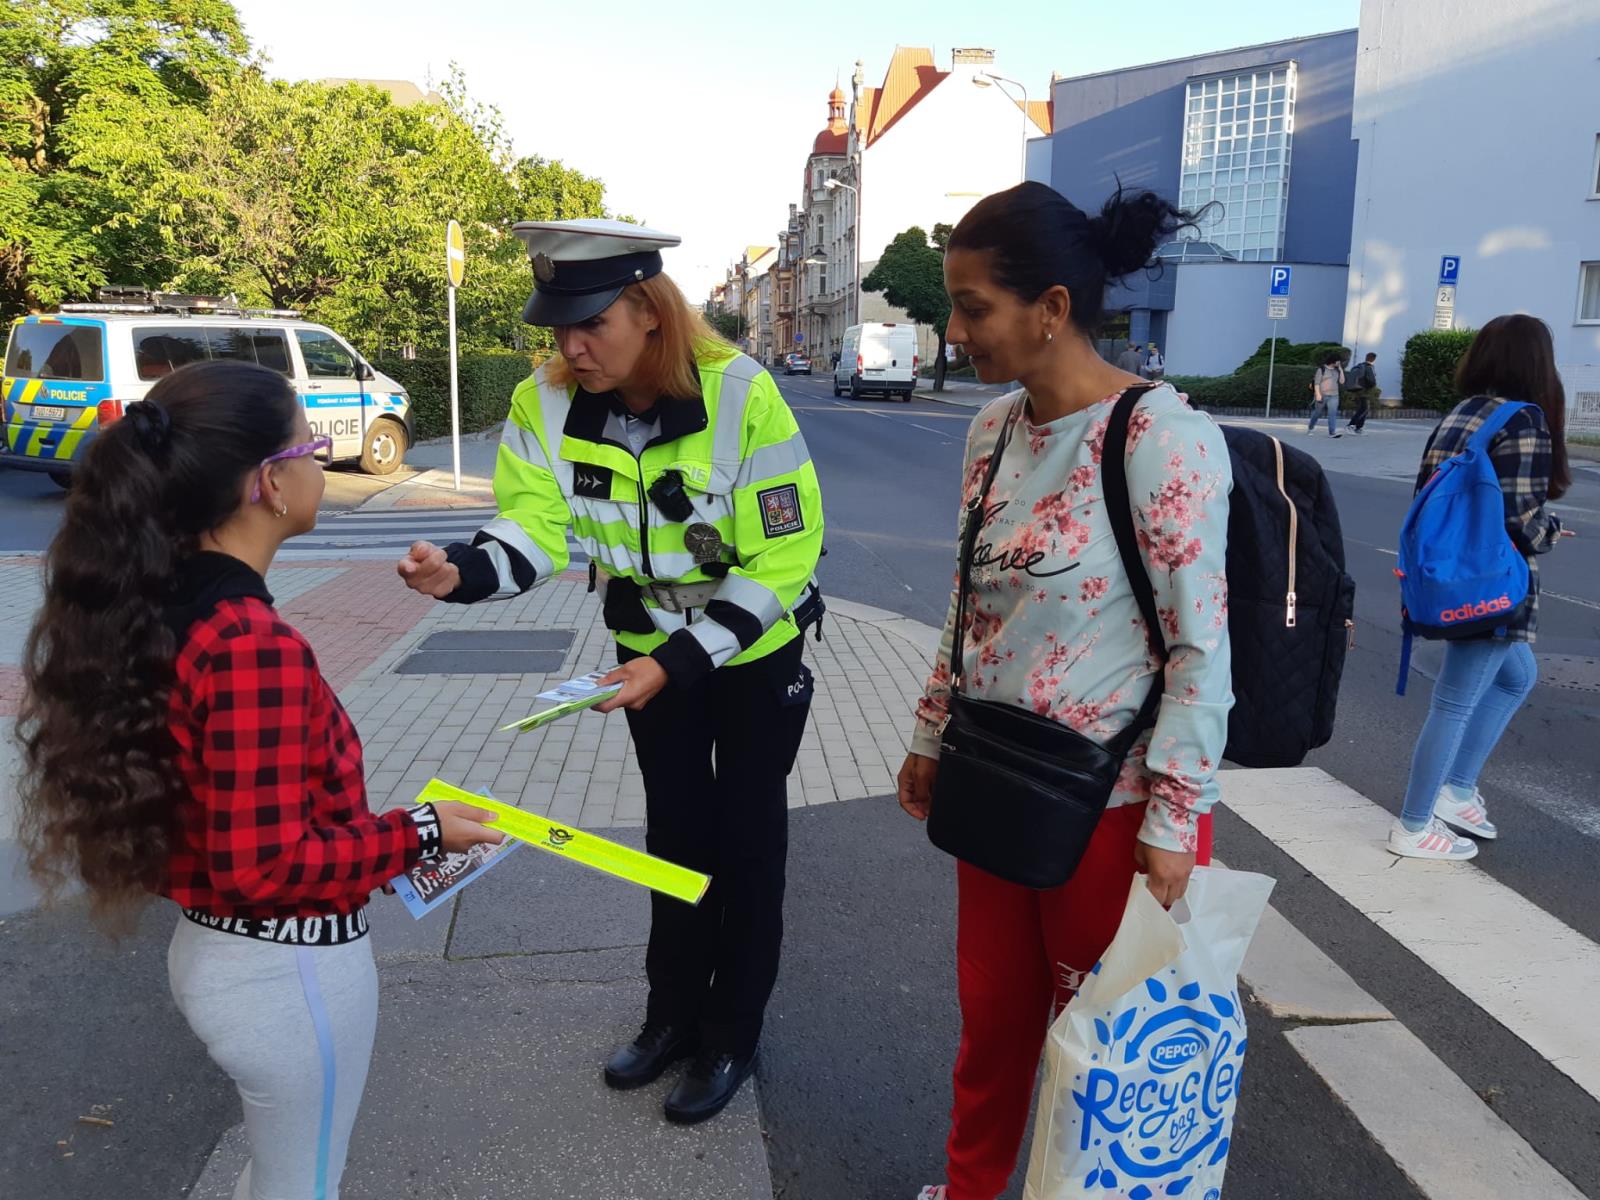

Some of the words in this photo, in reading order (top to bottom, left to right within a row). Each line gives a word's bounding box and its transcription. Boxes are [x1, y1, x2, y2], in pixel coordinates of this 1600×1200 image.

[1443, 259, 1456, 276] P
[1274, 269, 1287, 287] P
[50, 389, 87, 401] POLICIE
[309, 419, 359, 435] OLICIE
[769, 520, 799, 533] POLICIE
[1440, 594, 1512, 622] adidas
[258, 914, 338, 944] LOVE
[1155, 1042, 1198, 1060] PEPCO
[1072, 1031, 1234, 1151] Recycle
[1169, 1108, 1199, 1153] bag
